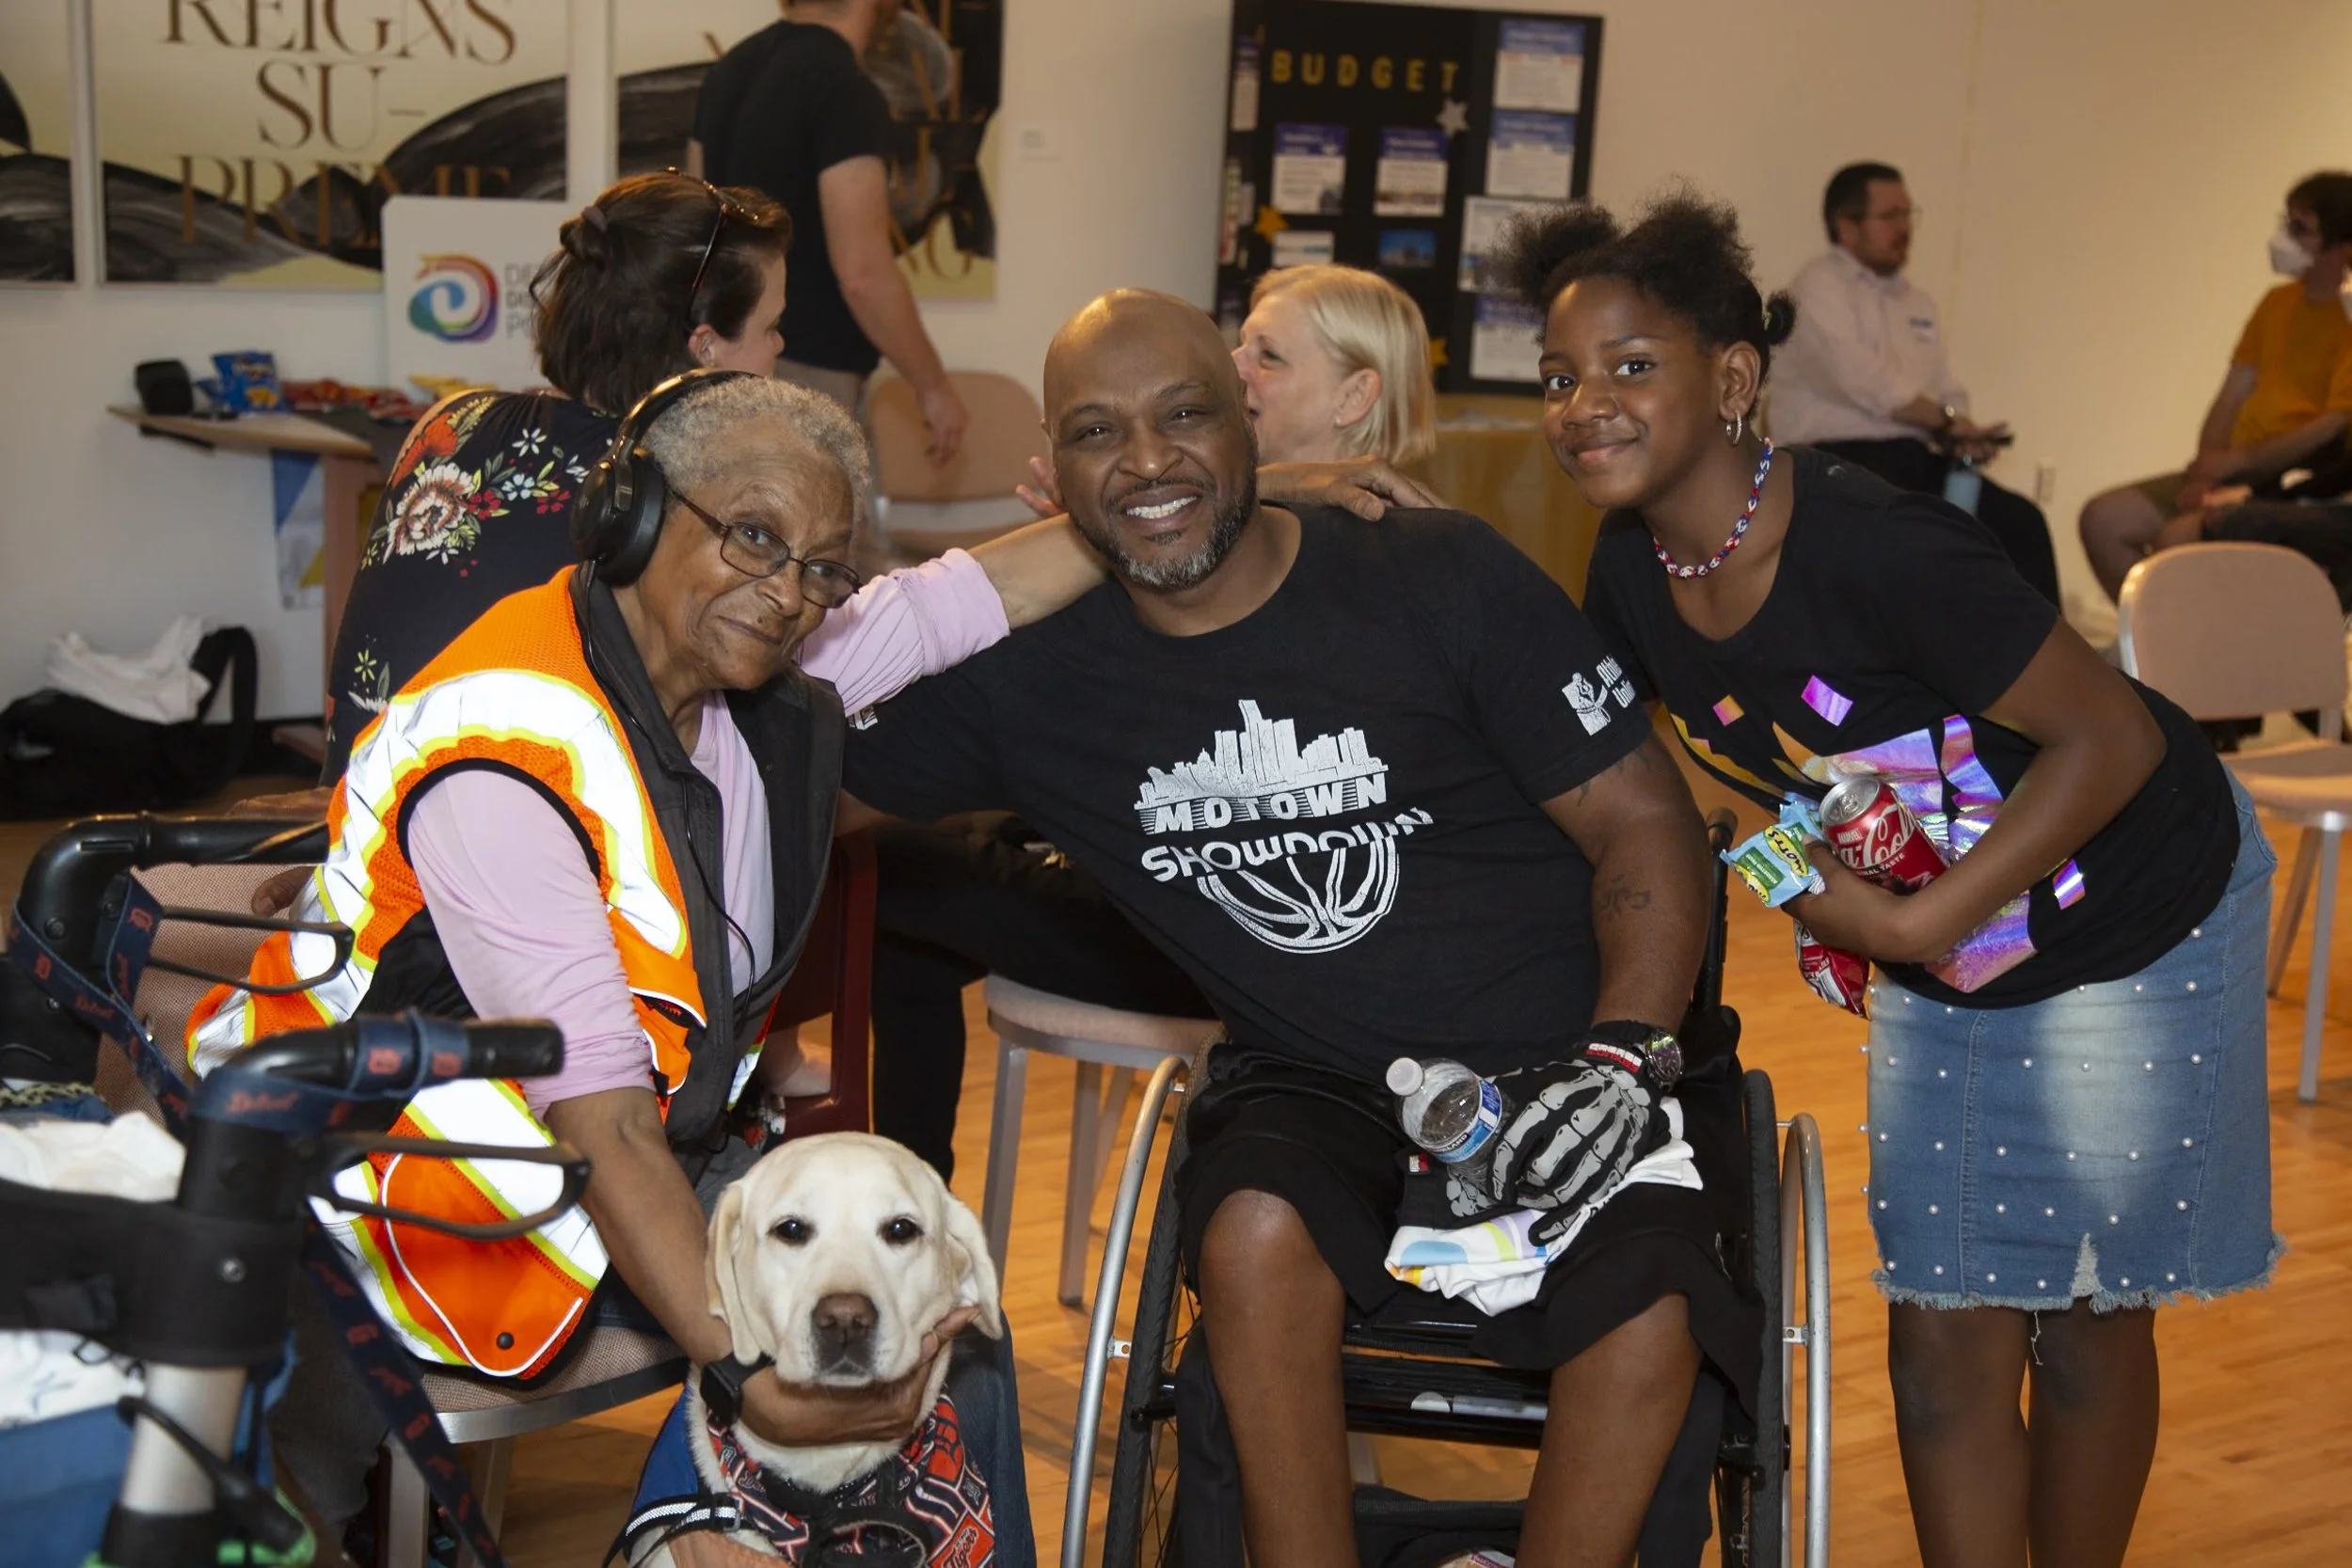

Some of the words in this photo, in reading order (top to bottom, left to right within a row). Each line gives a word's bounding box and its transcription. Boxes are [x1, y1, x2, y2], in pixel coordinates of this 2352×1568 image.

[1271, 49, 1460, 91] BUDGET
[1153, 772, 1387, 833] MOTOWN
[1881, 853, 1906, 872] TASTE
